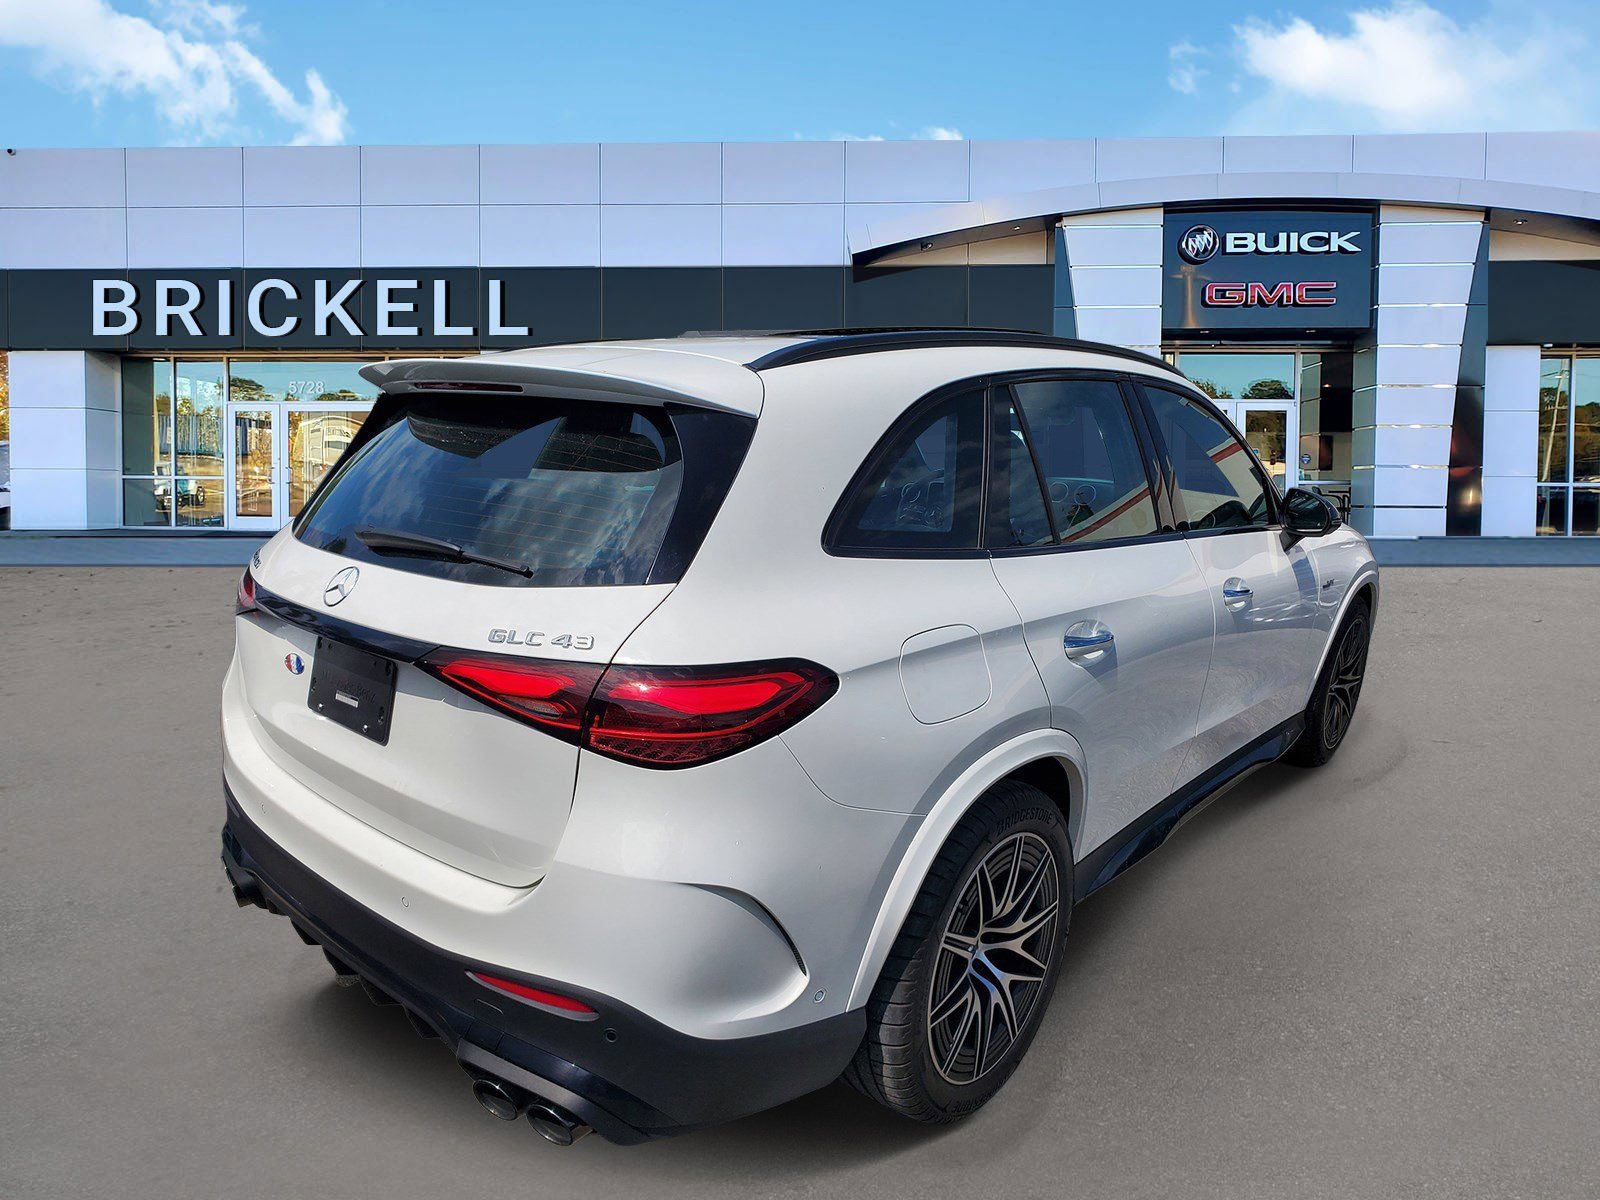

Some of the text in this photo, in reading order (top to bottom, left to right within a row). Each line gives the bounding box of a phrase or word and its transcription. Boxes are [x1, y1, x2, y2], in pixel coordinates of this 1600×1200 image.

[1225, 231, 1361, 253] BUICK
[1205, 281, 1337, 305] GMC
[92, 279, 531, 337] BRICKELL
[289, 381, 325, 394] 5728
[488, 628, 595, 650] GLC 43
[999, 807, 1053, 833] BRIDGESTONE
